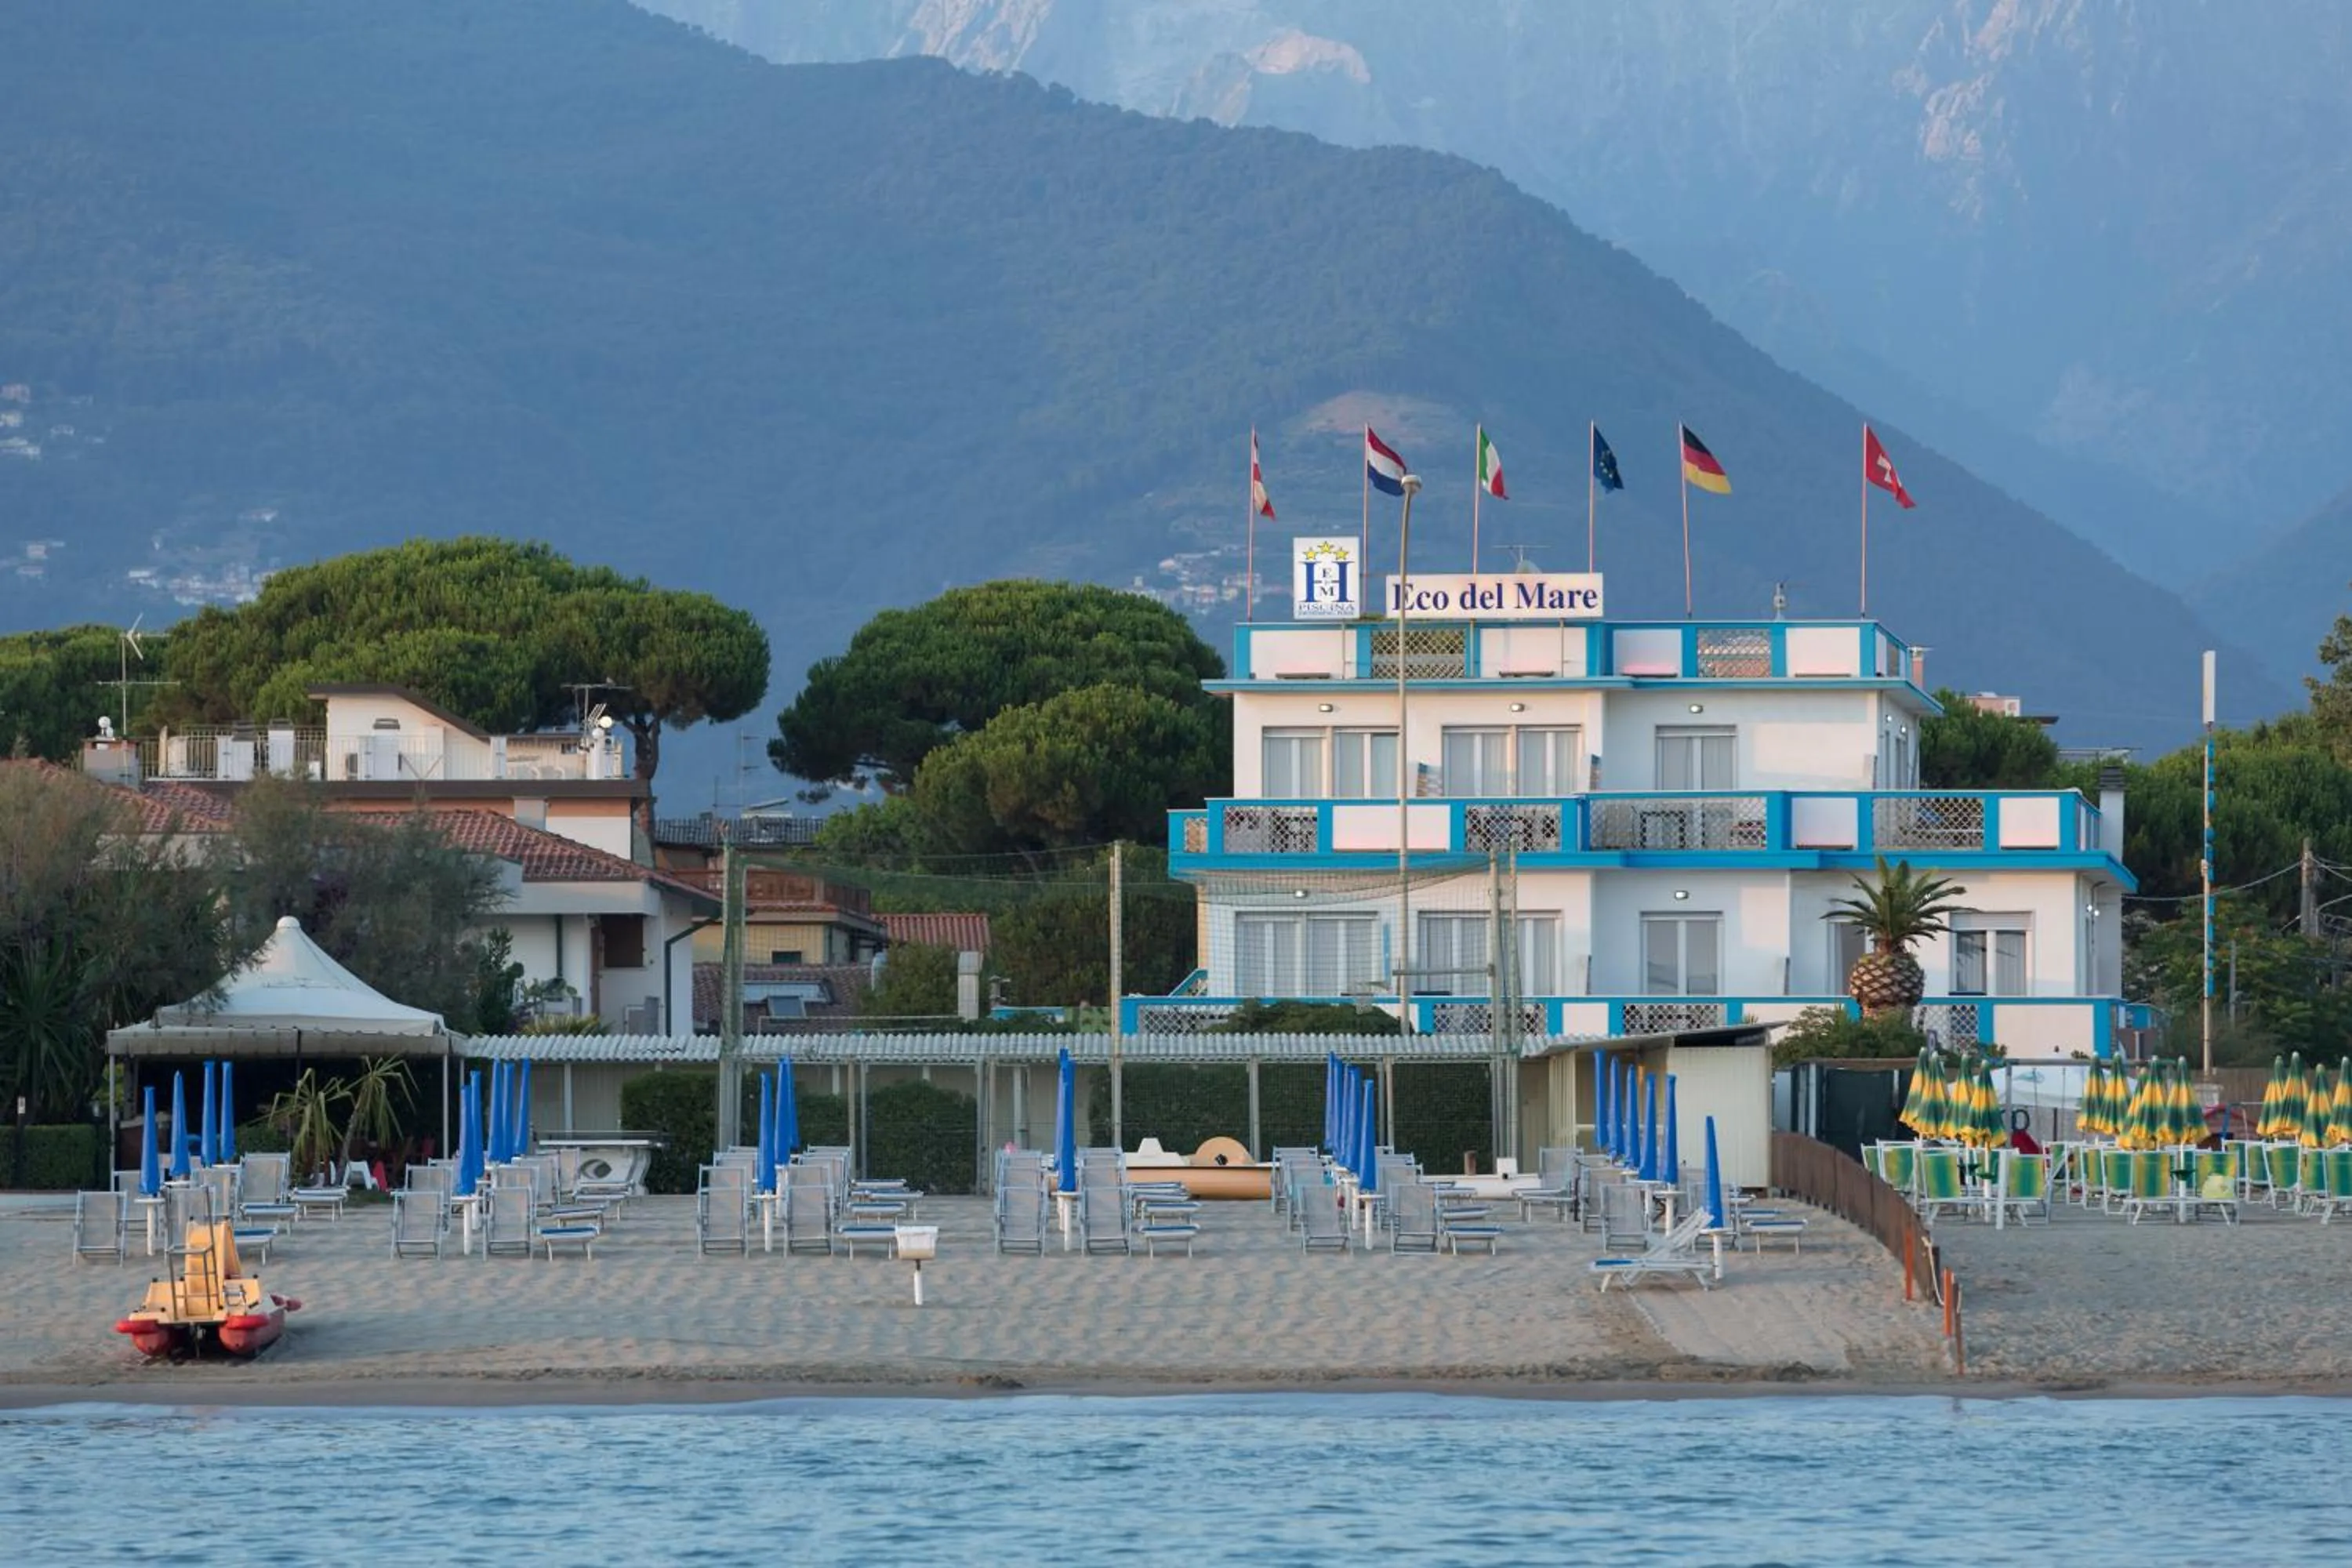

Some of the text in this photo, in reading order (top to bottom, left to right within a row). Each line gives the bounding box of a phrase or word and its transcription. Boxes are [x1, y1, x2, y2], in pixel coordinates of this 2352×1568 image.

[1319, 586, 1334, 596] M
[1392, 582, 1597, 611] Eco del Mare
